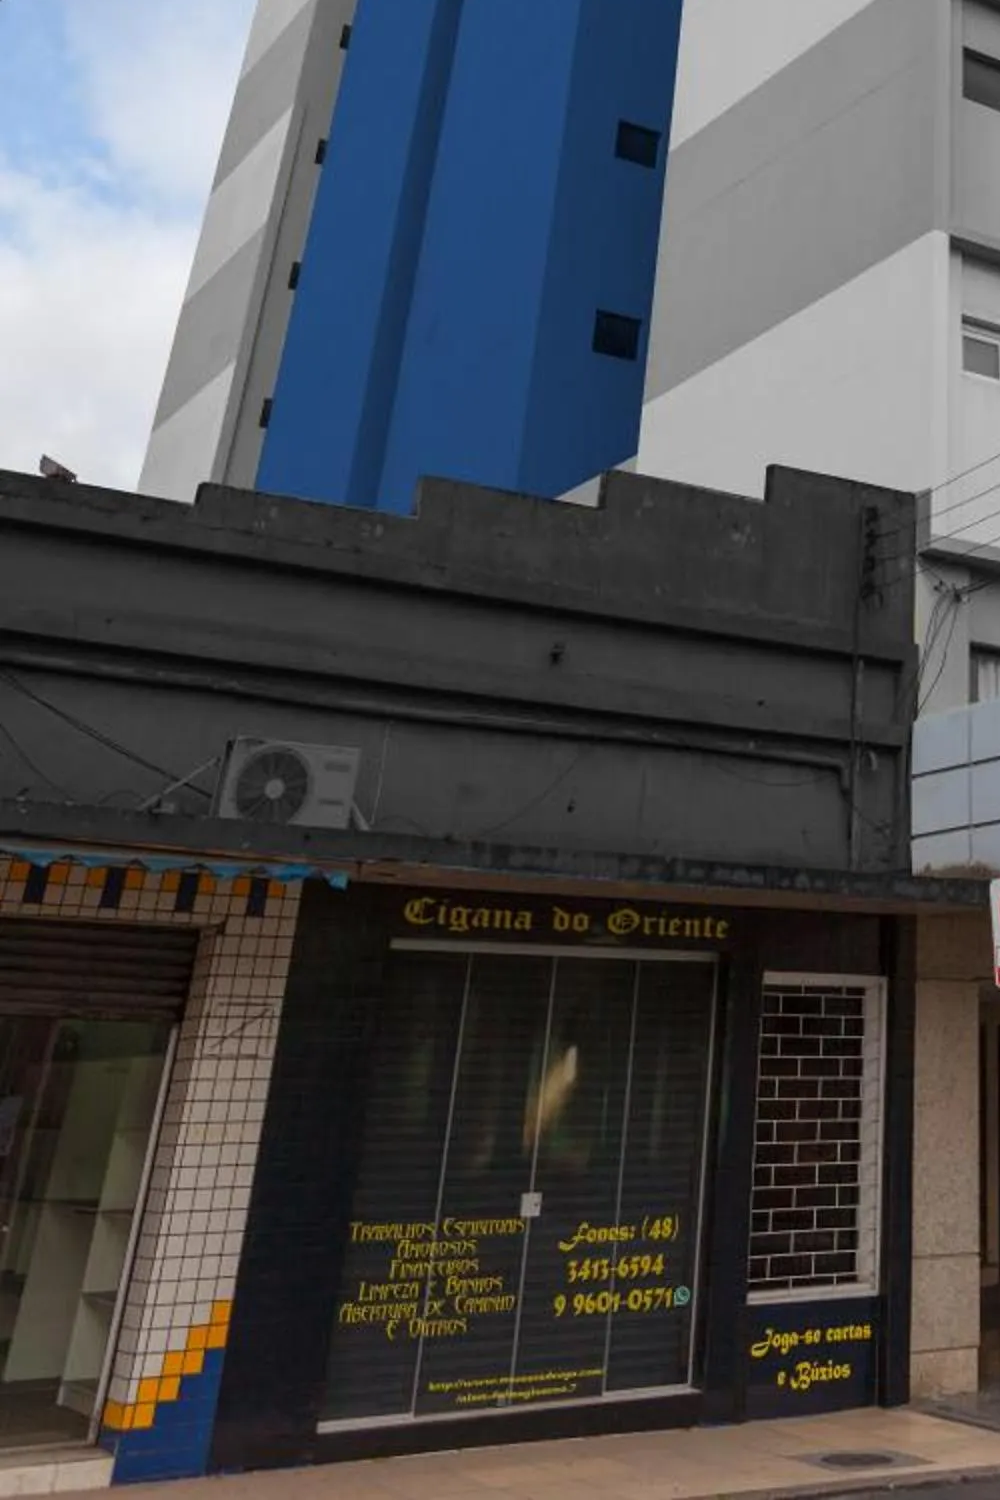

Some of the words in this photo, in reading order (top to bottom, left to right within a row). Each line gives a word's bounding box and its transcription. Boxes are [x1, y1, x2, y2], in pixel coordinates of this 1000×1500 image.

[404, 897, 532, 932] Cigana
[553, 905, 589, 933] do
[607, 908, 729, 939] Oriente
[641, 1213, 679, 1242] (48)
[567, 1253, 665, 1283] 3413-6594
[554, 1292, 567, 1317] 9
[572, 1287, 673, 1315] 9601-0571
[751, 1327, 821, 1358] Joga-se
[825, 1323, 872, 1343] cartas
[777, 1370, 787, 1386] e
